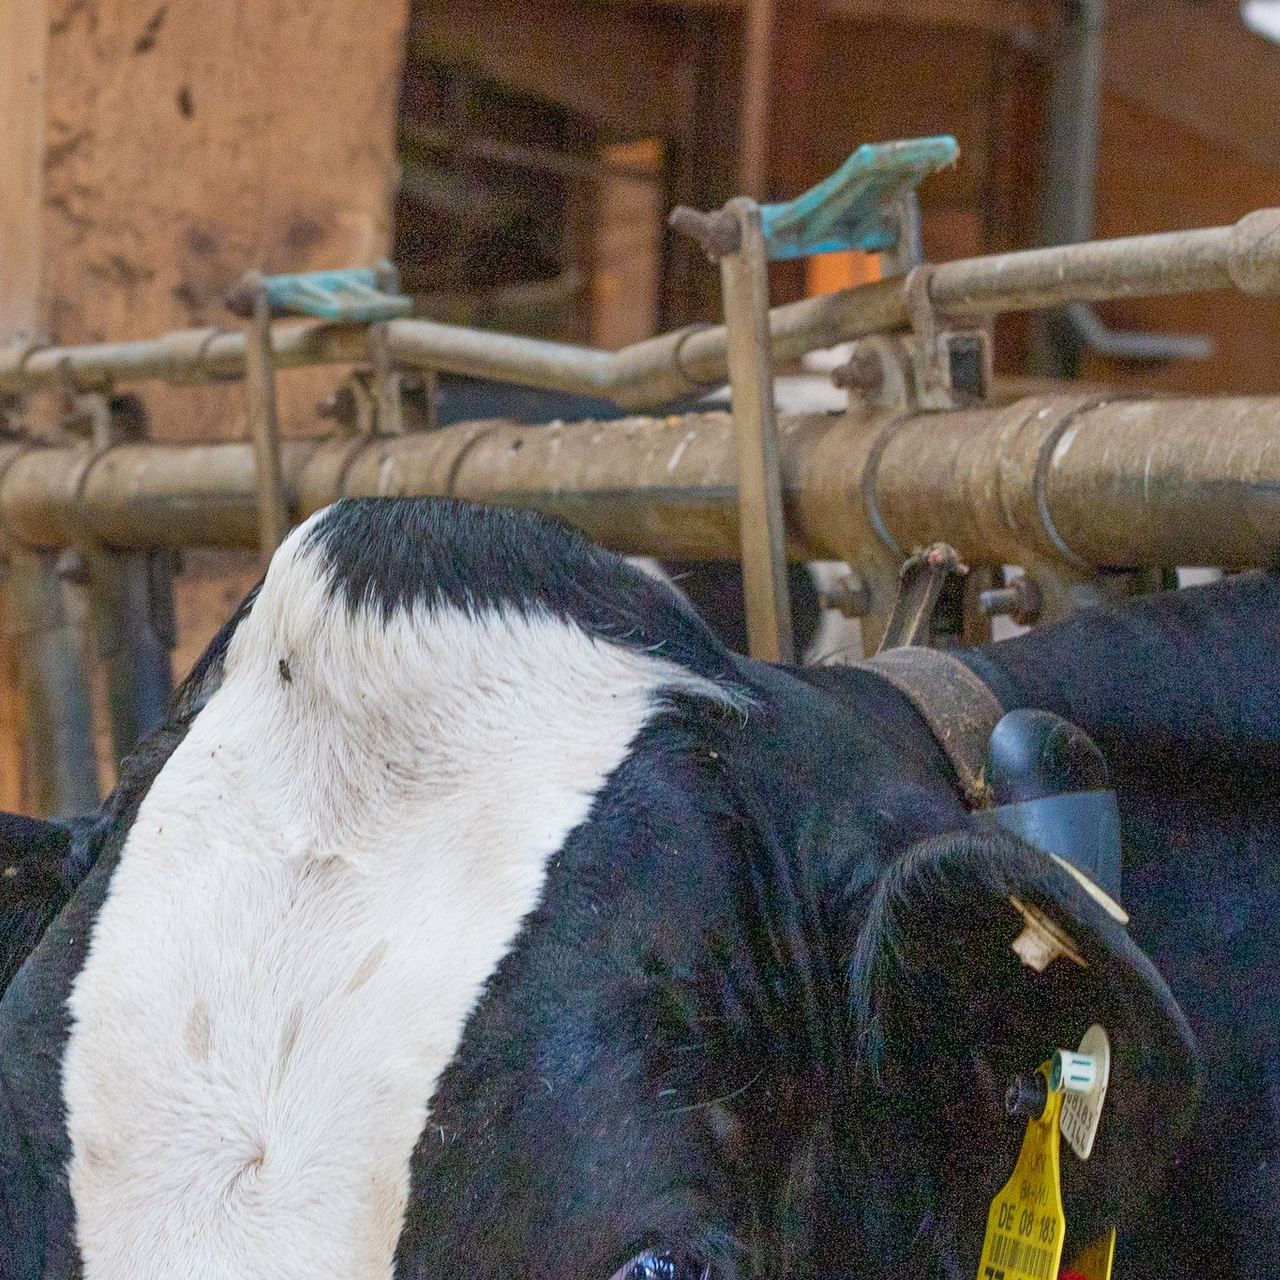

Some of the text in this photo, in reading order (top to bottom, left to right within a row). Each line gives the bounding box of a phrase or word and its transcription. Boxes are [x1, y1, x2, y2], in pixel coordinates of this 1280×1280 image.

[998, 1202, 1056, 1243] DE 08 183
